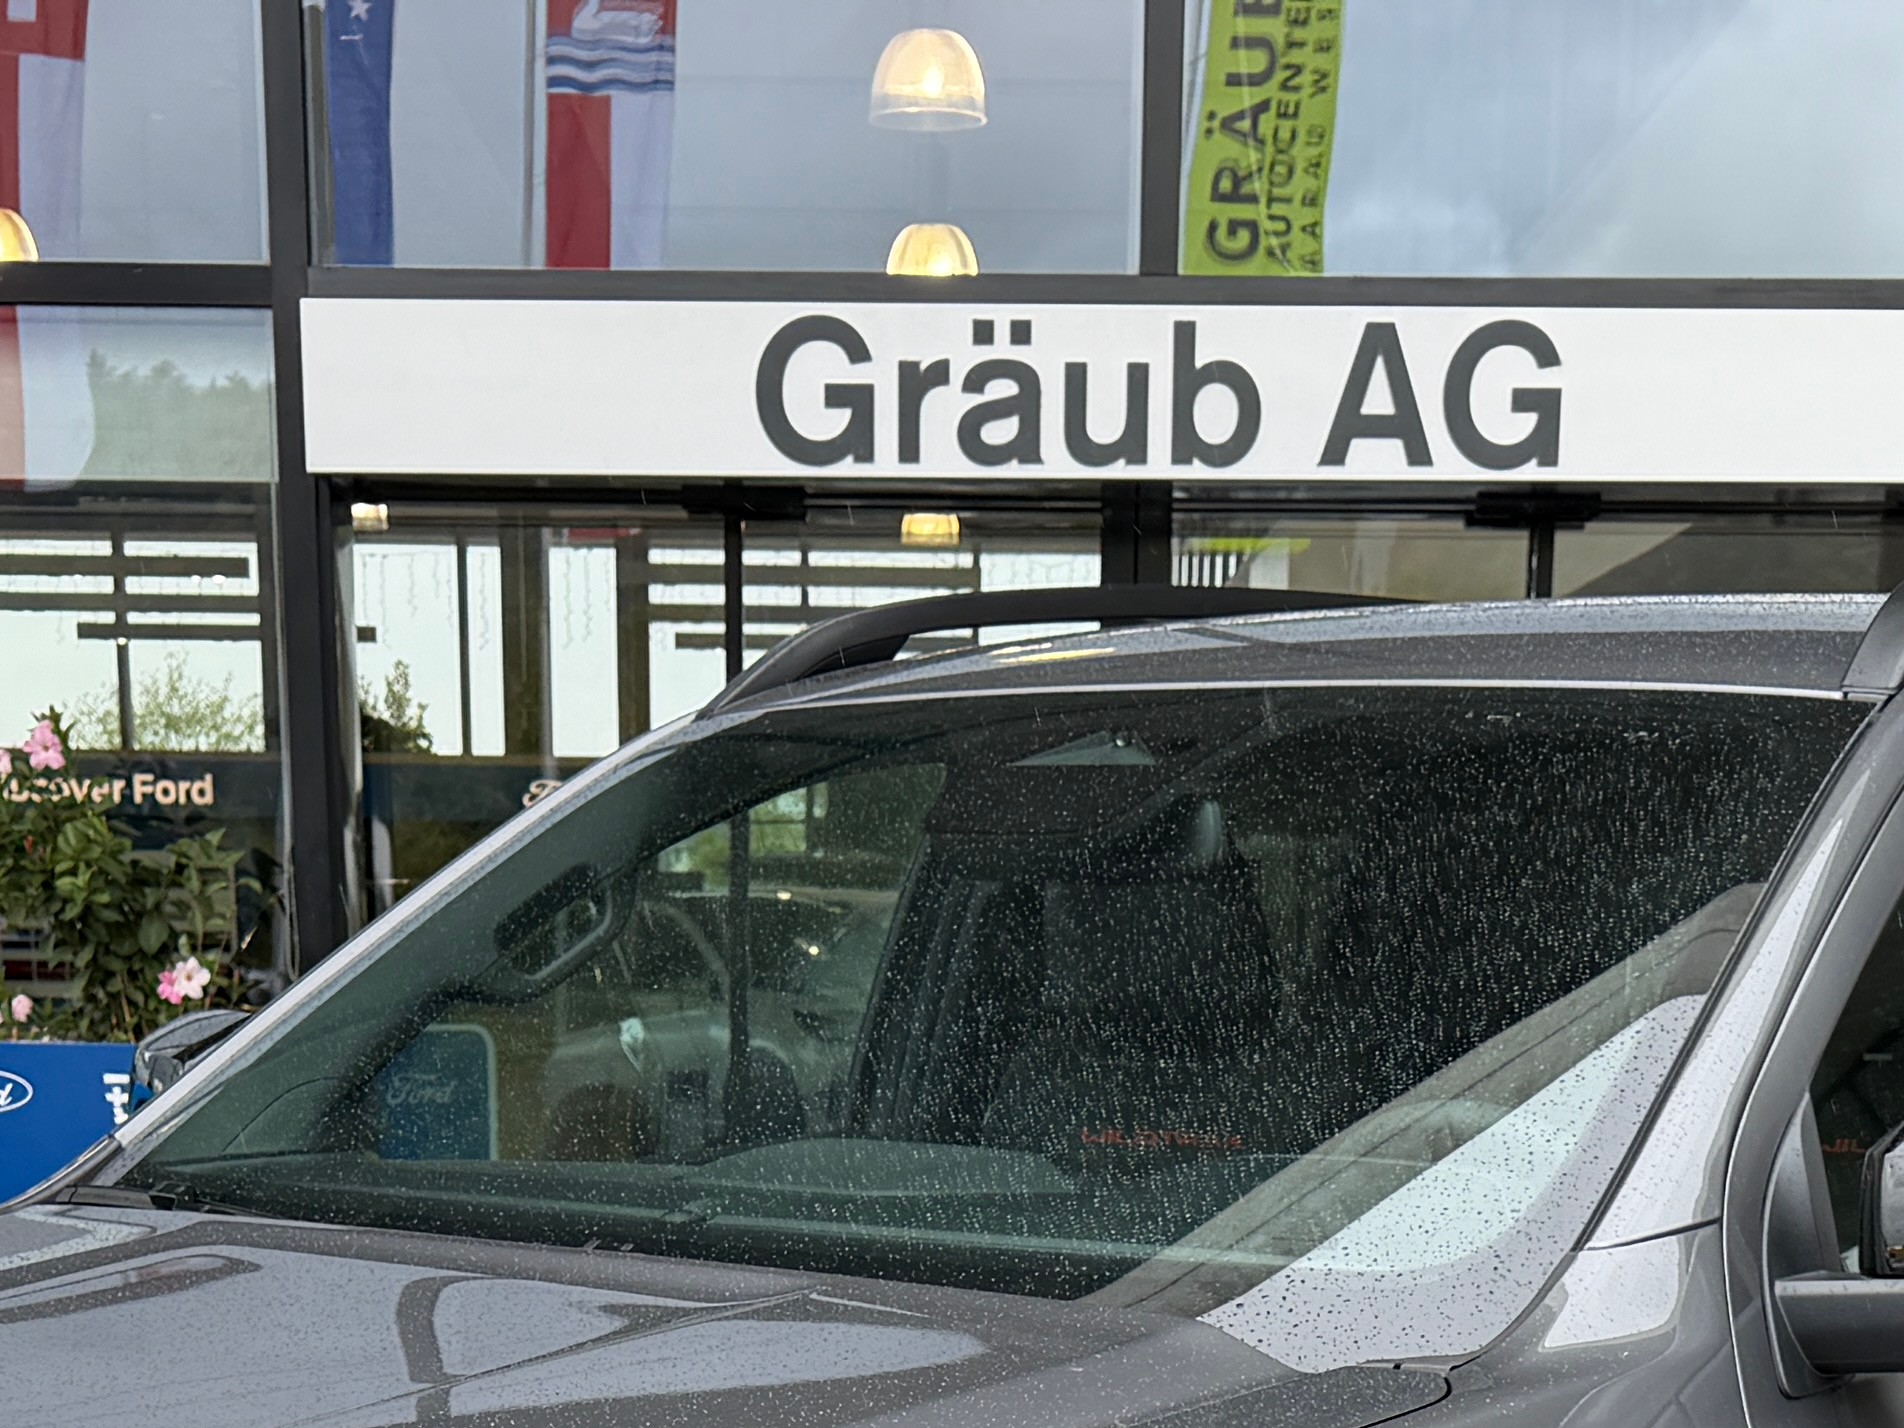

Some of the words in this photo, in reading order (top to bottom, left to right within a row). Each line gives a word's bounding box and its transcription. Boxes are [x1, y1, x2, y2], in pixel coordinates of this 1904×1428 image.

[756, 314, 1262, 468] Gräub
[1318, 319, 1563, 470] AG
[132, 772, 214, 806] Ford
